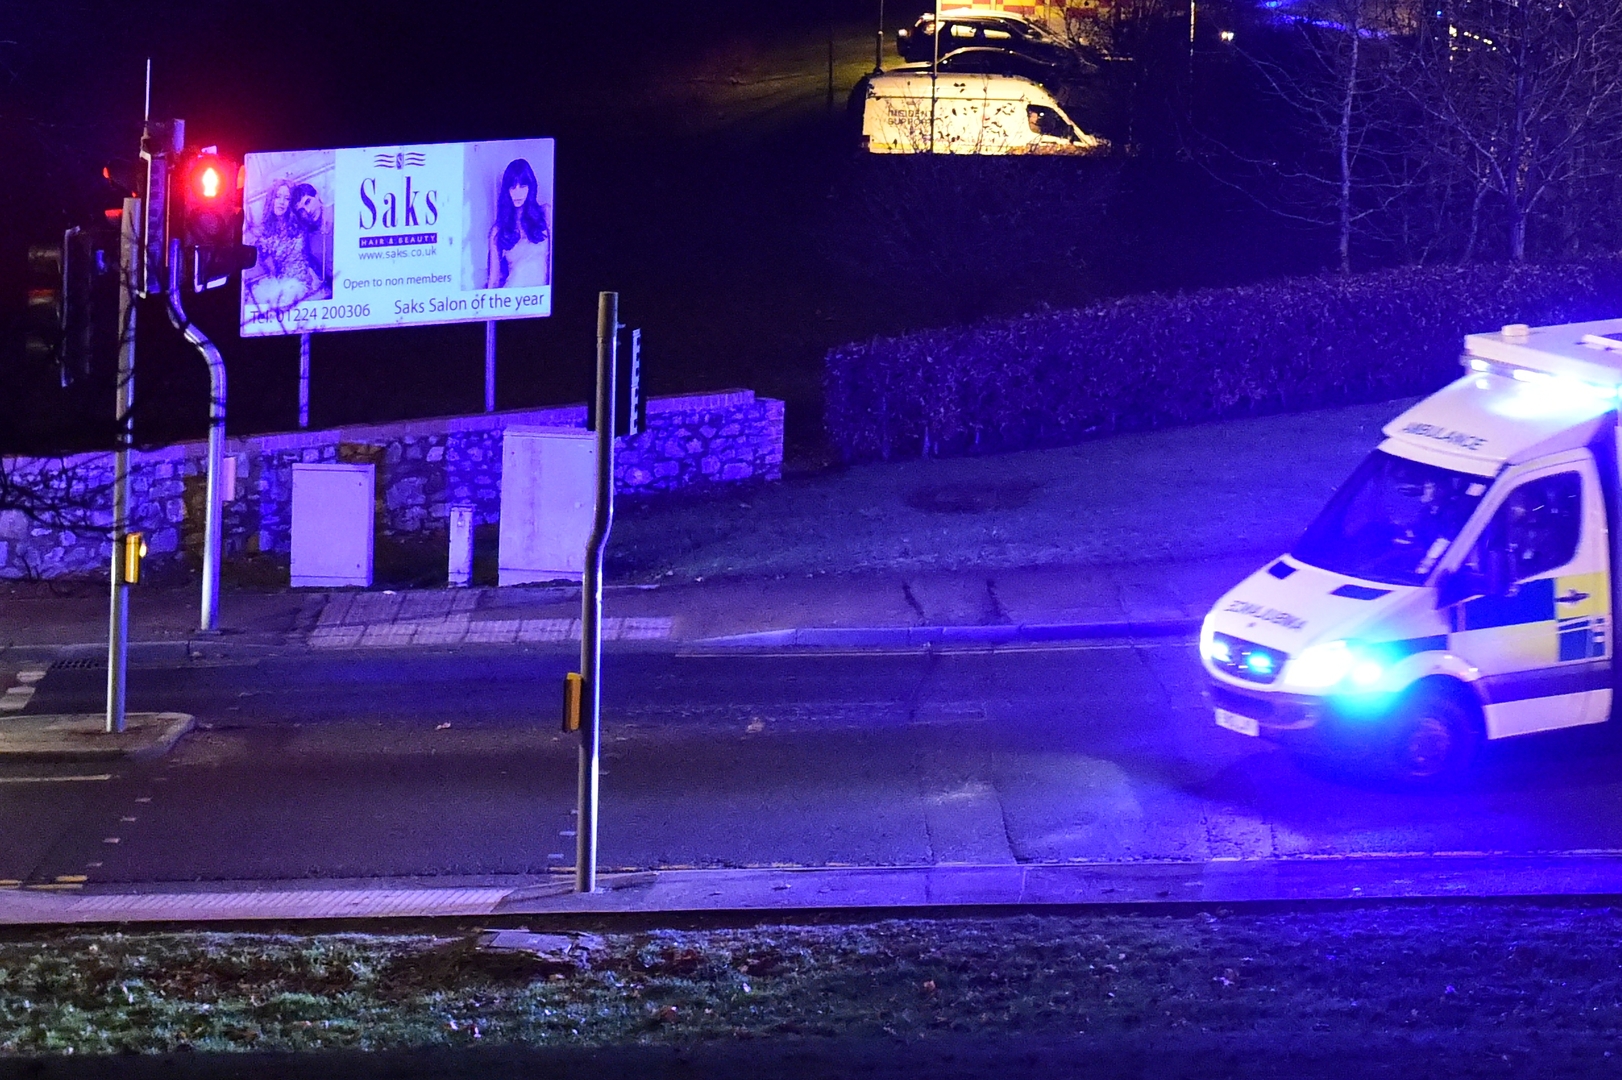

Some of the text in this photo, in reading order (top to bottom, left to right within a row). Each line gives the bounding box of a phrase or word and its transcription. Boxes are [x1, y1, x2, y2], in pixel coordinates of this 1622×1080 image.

[359, 175, 438, 230] Saks
[361, 238, 385, 247] HAIR
[398, 234, 436, 245] BEAUTY
[358, 246, 437, 260] www.saks.co.uk
[343, 273, 452, 290] Open to non members
[276, 307, 318, 323] 01224
[321, 303, 371, 320] 200306
[394, 293, 545, 315] Saks Salon of the year
